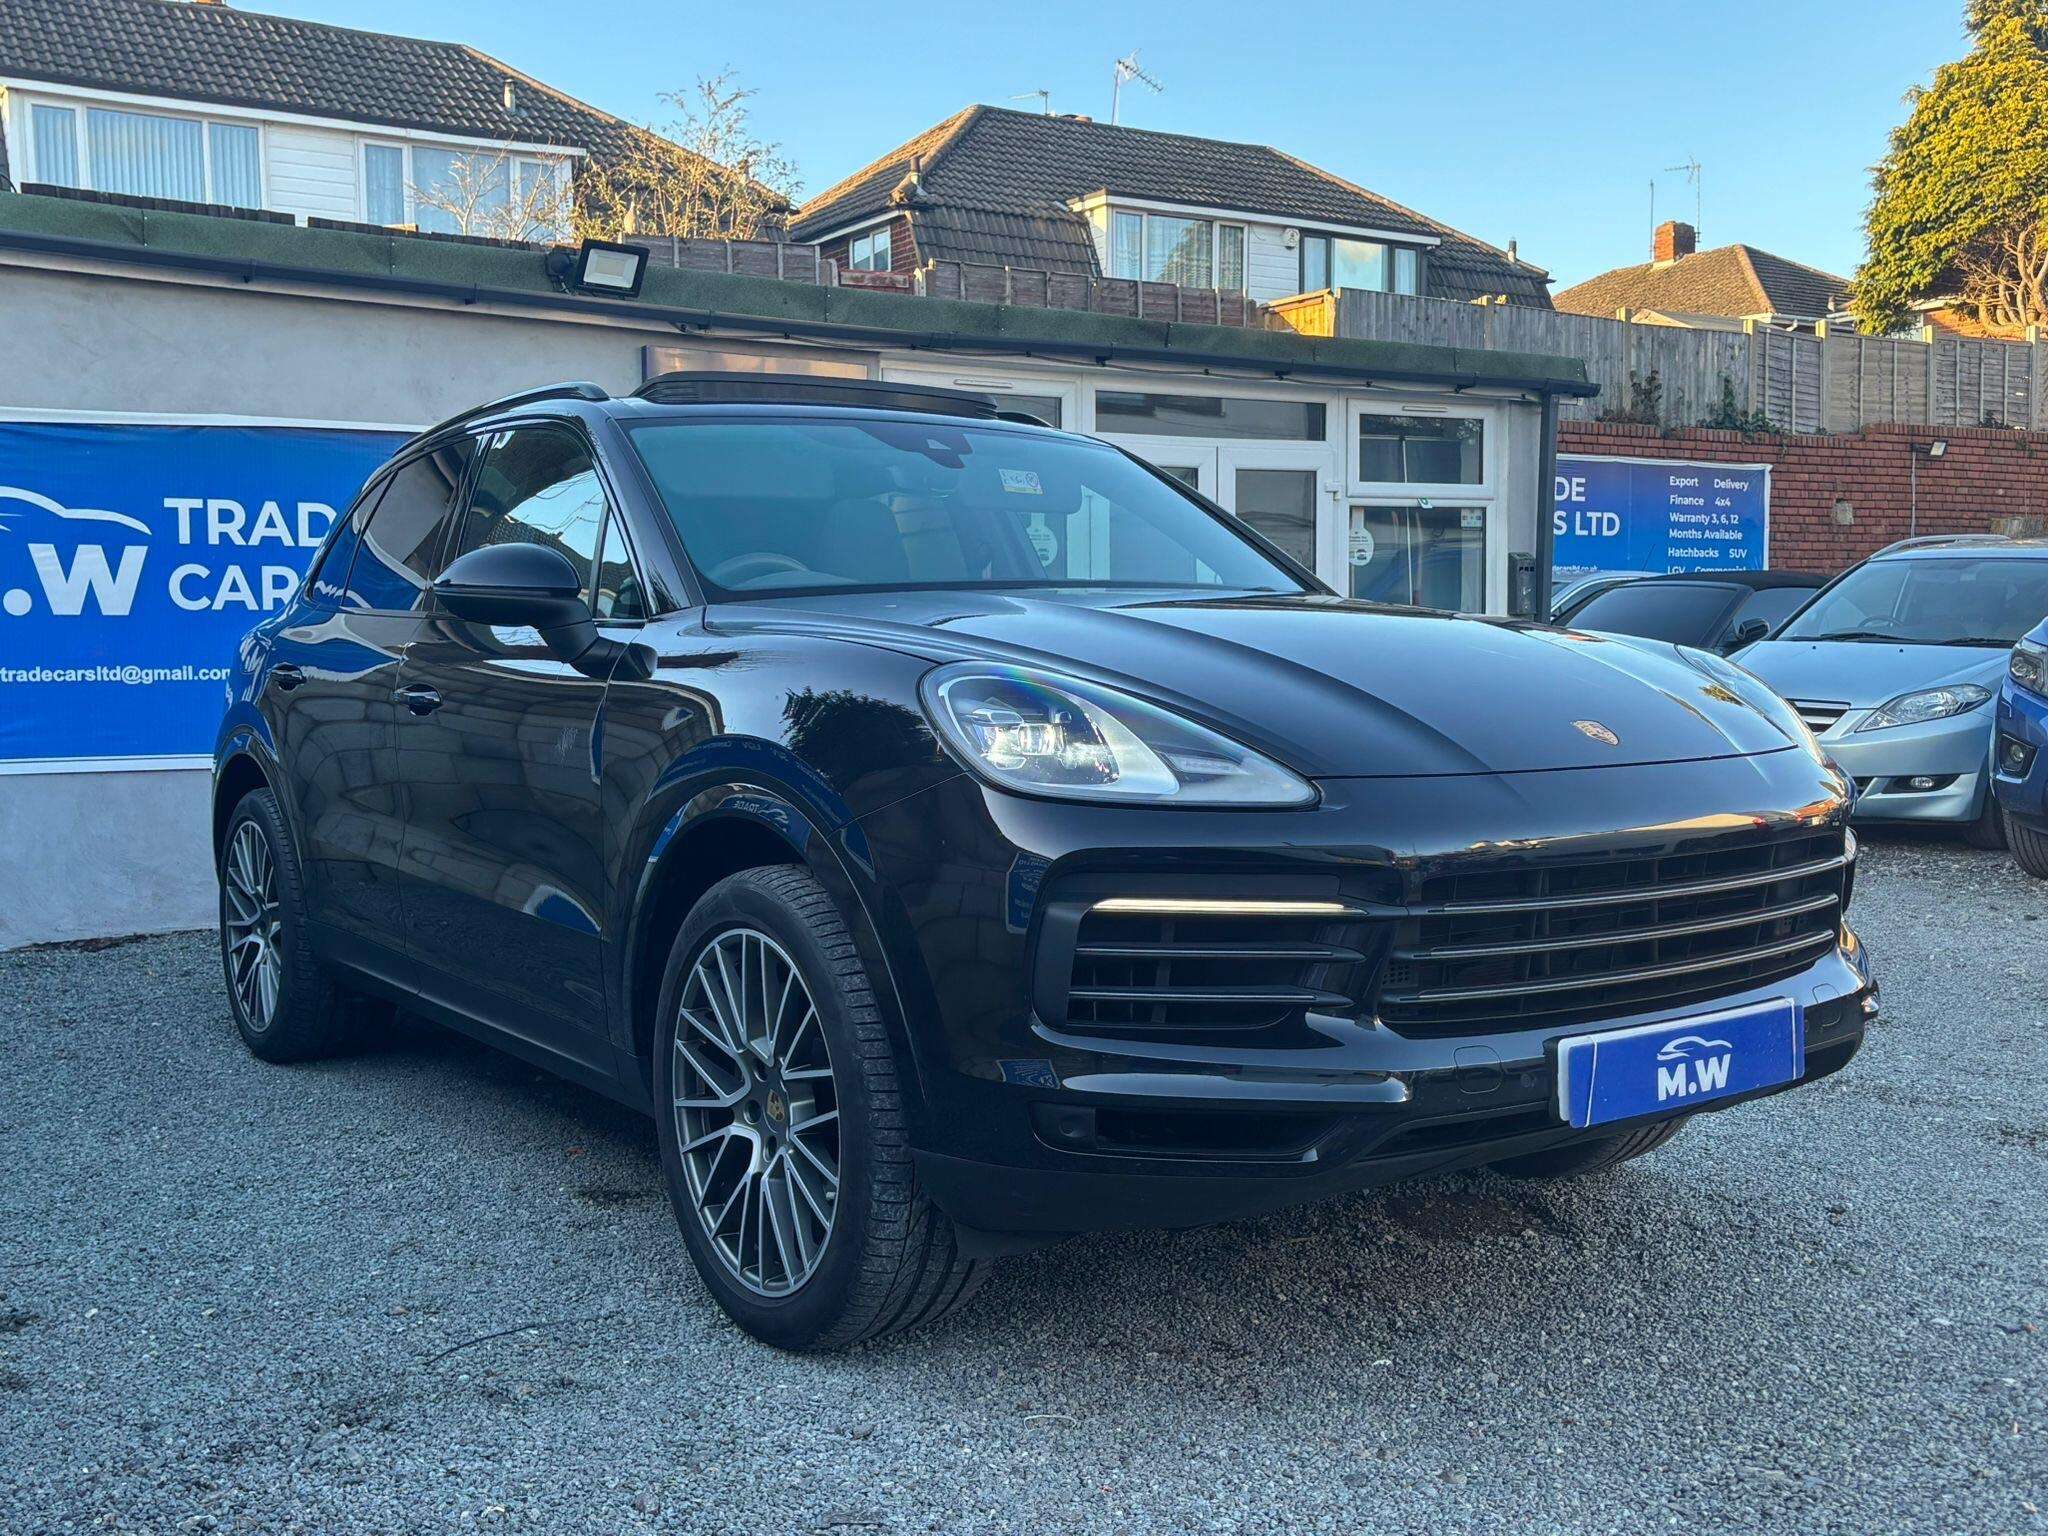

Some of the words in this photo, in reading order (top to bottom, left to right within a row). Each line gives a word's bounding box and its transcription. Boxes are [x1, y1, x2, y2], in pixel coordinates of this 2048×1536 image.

[1555, 476, 1586, 501] DE
[1669, 476, 1699, 488] Export
[1714, 478, 1749, 491] Delivery
[1669, 495, 1704, 506] Finance
[1714, 497, 1731, 506] 4x4
[164, 498, 338, 547] TRAD
[1553, 511, 1567, 536] S
[1575, 511, 1621, 536] LTD
[1669, 512, 1710, 525] Warranty
[1711, 513, 1719, 525] 3,
[1720, 514, 1729, 525] 6,
[1730, 515, 1739, 524] 12
[1669, 529, 1702, 539] Months
[1703, 530, 1743, 540] Available
[1668, 547, 1719, 558] Hatchbacks
[1729, 548, 1748, 558] SUV
[168, 563, 300, 611] CAR
[1657, 1053, 1731, 1101] M.W
